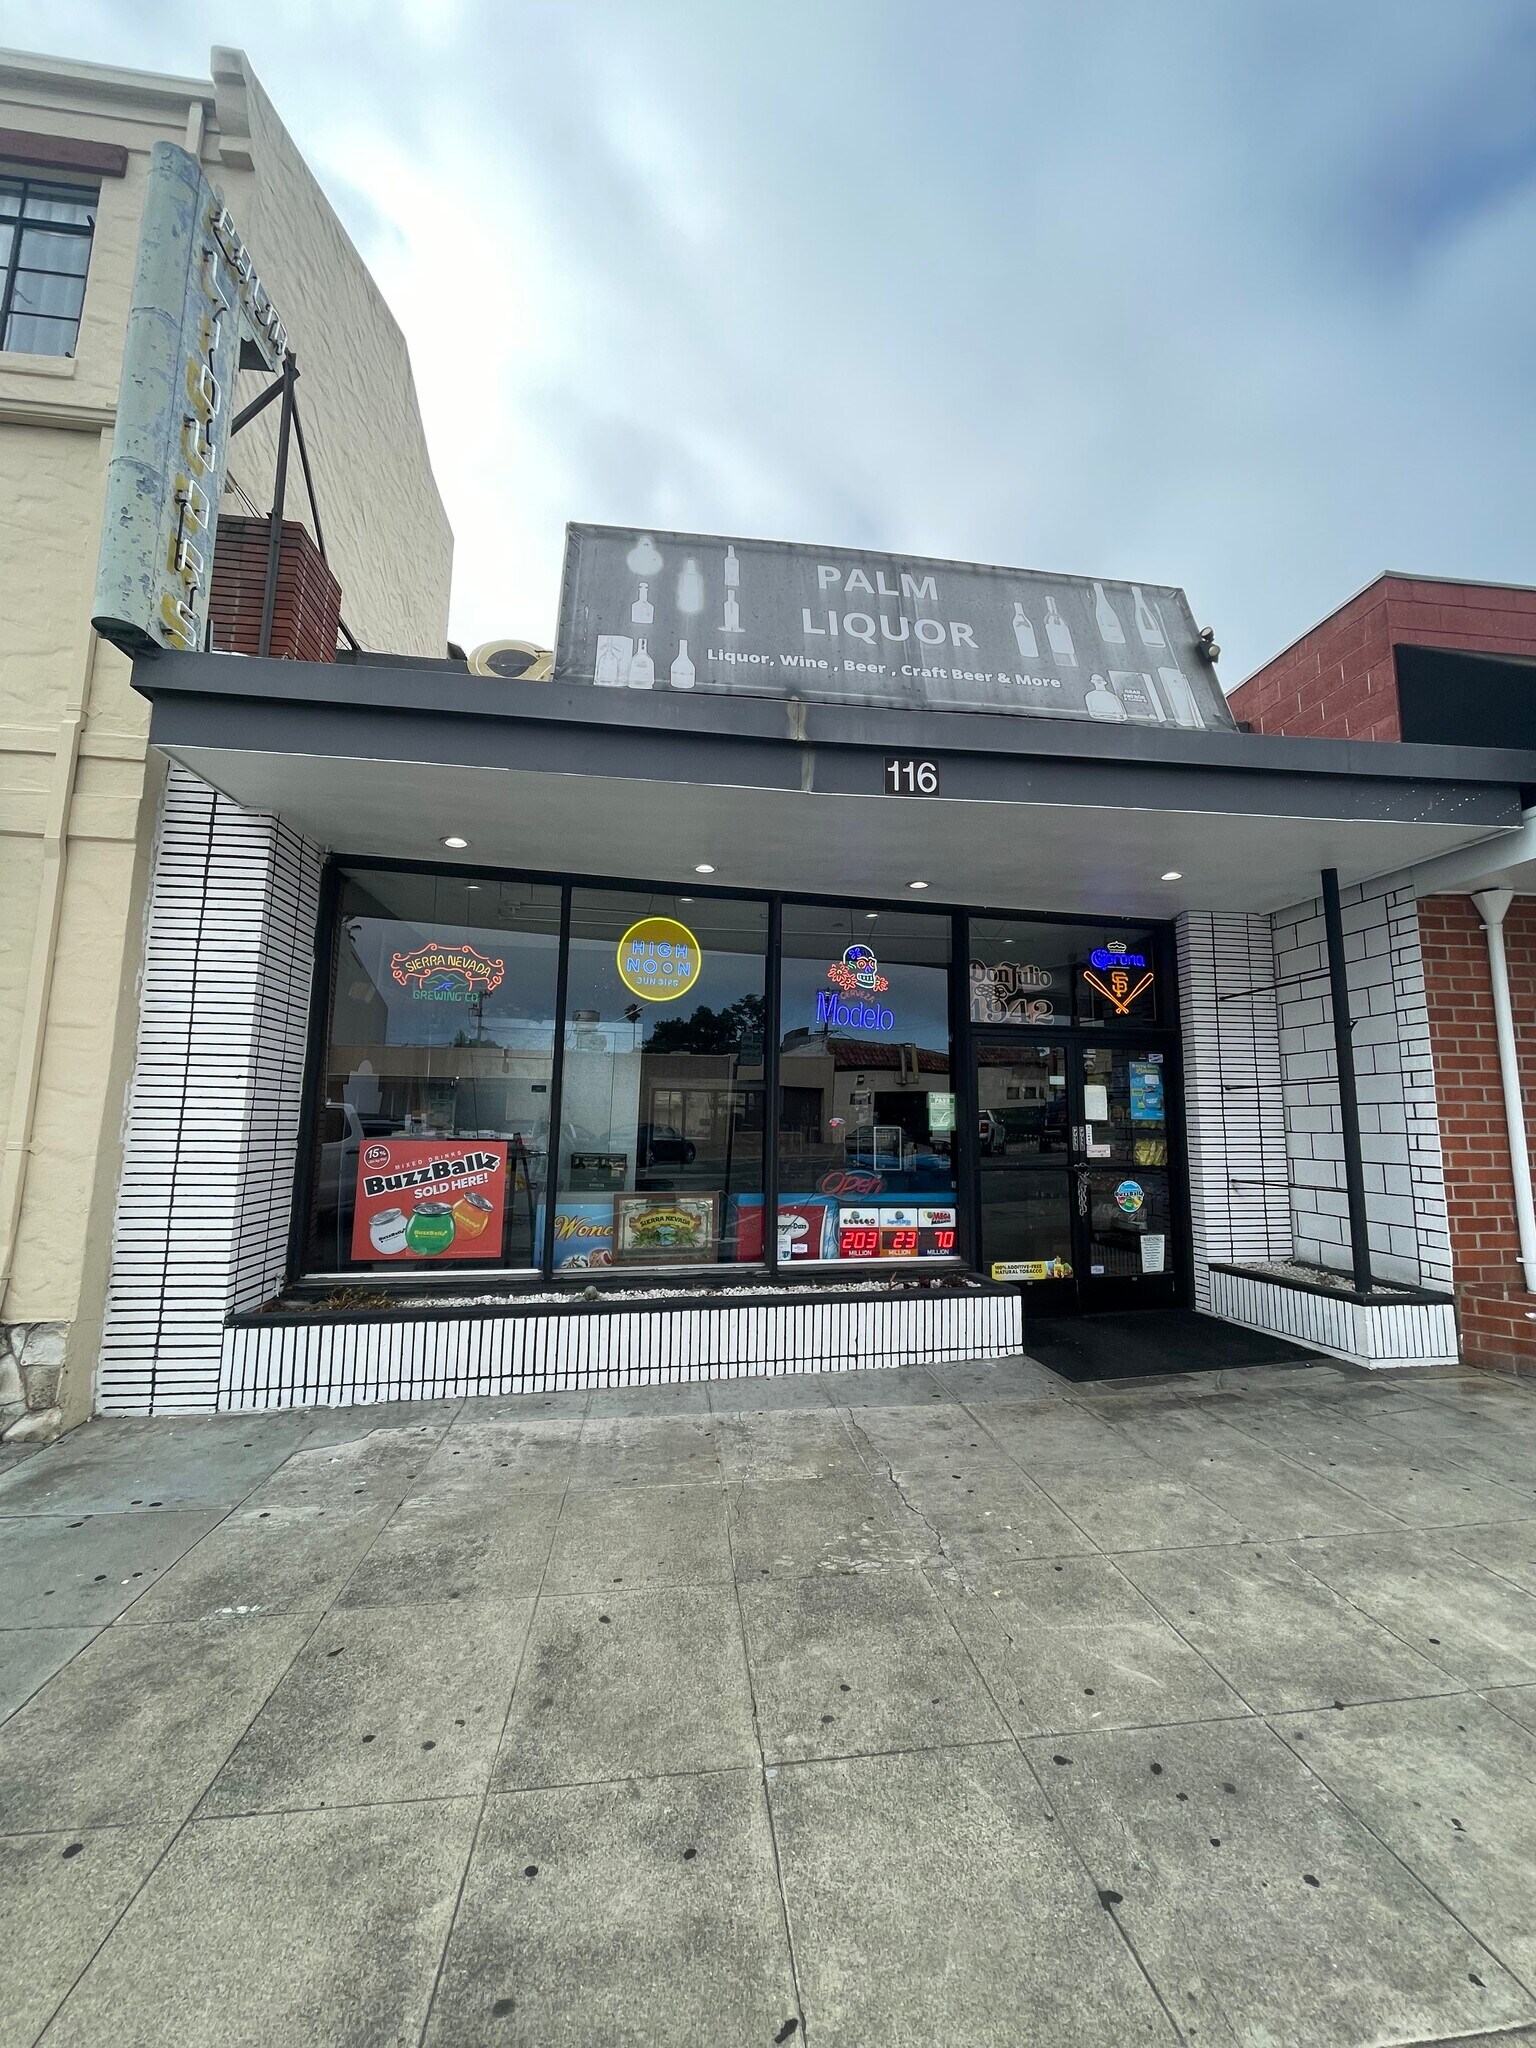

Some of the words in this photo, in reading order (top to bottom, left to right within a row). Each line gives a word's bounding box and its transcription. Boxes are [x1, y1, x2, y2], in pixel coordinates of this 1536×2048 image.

[817, 565, 939, 600] PALM
[802, 608, 980, 649] LIQUOR
[707, 649, 775, 666] Liquor,
[901, 665, 948, 679] Craft
[952, 669, 993, 682] Beer
[998, 673, 1012, 684] &
[1015, 674, 1061, 688] More
[887, 760, 938, 793] 116
[632, 940, 688, 959] HIGH
[1091, 949, 1146, 970] Corona
[405, 955, 446, 972] SIERRA
[447, 955, 492, 977] NEVADA
[626, 957, 691, 977] NOON
[969, 958, 1010, 983] Don
[1001, 961, 1053, 995] Julio
[637, 976, 656, 985] SUN
[657, 978, 679, 987] SIPS
[840, 989, 876, 1003] CERVEZA
[816, 991, 894, 1030] Modelo
[970, 998, 1055, 1025] 1942
[394, 1159, 423, 1170] MIXED
[428, 1150, 462, 1163] DRINKS
[363, 1151, 500, 1197] BuzzBallz
[821, 1171, 883, 1195] Open
[414, 1182, 450, 1199] SOLD
[451, 1172, 489, 1191] HERE!
[640, 1216, 664, 1227] SIERRA
[665, 1216, 691, 1226] NEVADA
[842, 1231, 878, 1249] 203
[893, 1231, 917, 1249] 23
[935, 1231, 954, 1248] 70
